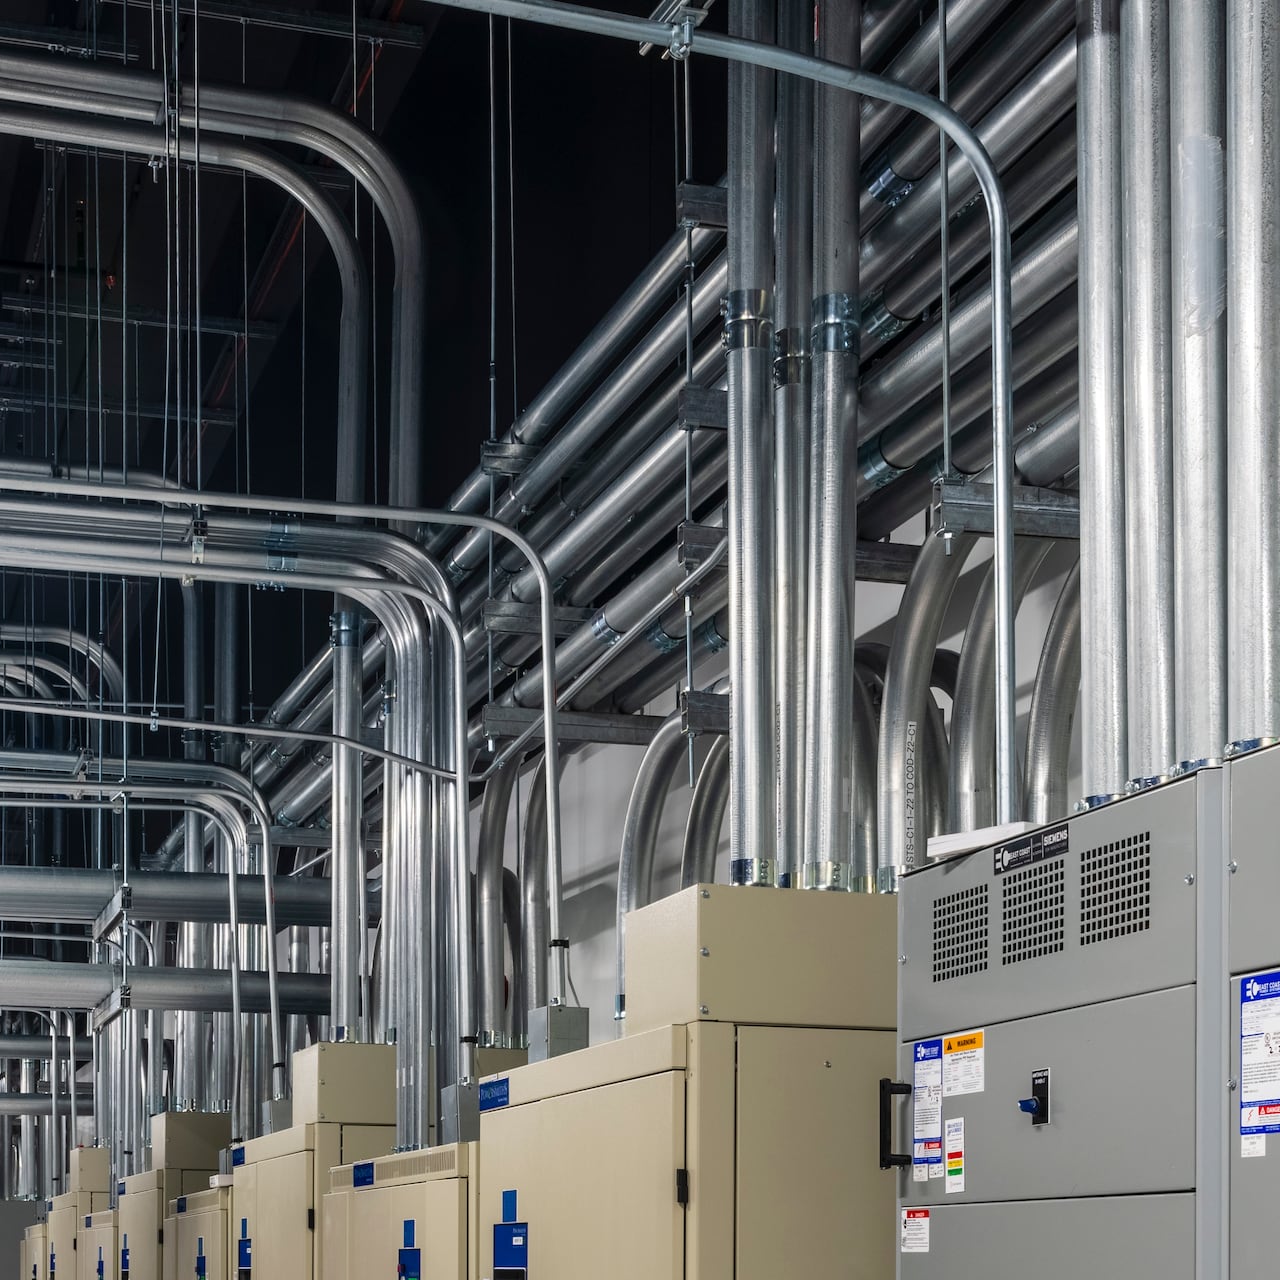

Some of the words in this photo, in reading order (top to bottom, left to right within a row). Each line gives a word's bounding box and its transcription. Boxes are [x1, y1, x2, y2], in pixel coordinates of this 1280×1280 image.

[906, 782, 915, 796] TO
[906, 798, 915, 863] STS-C1-1-Z2
[1043, 829, 1068, 846] SIEMENS
